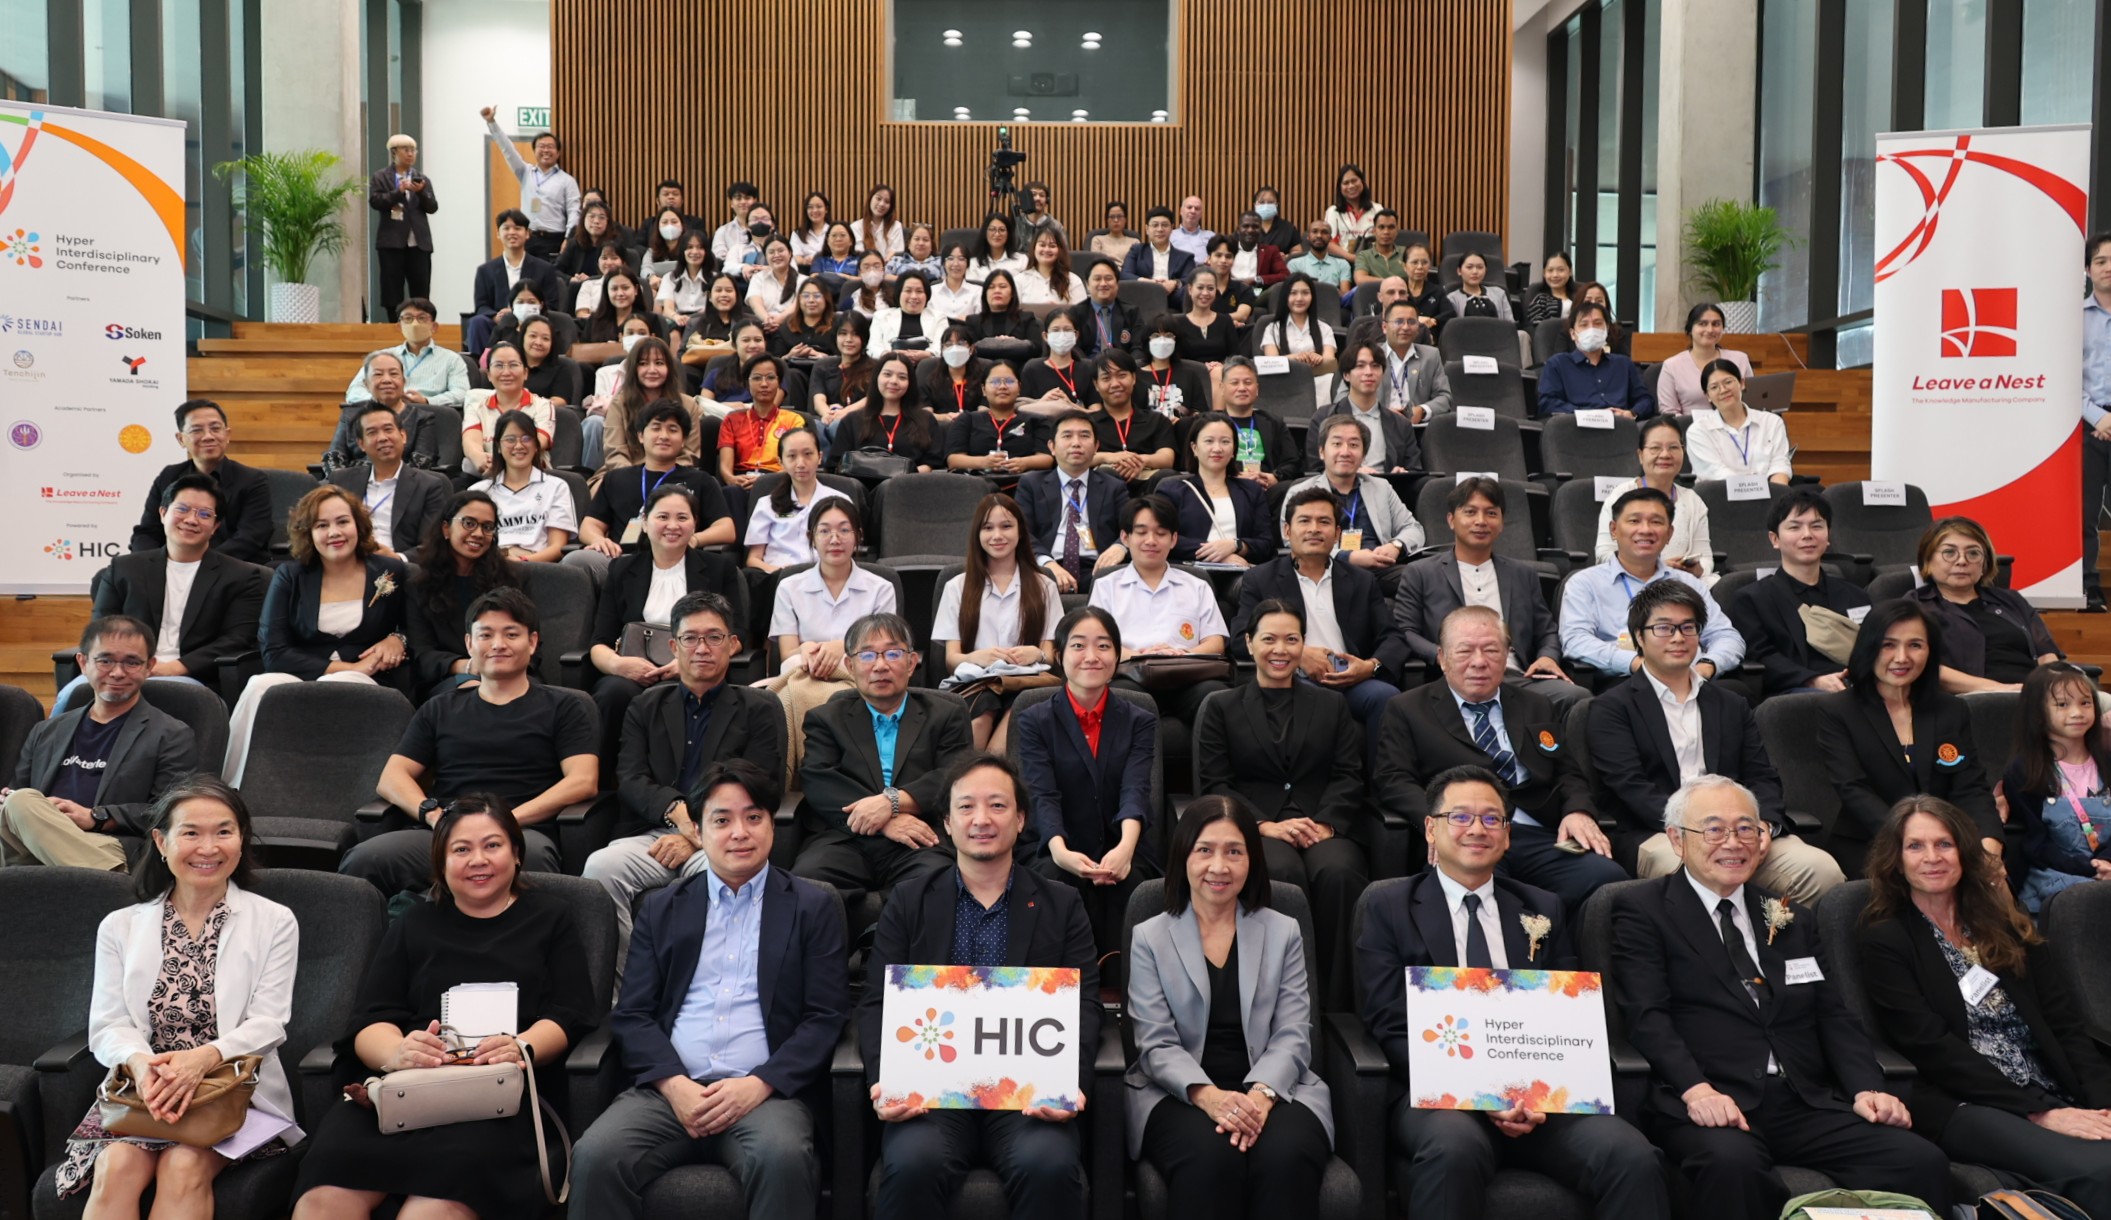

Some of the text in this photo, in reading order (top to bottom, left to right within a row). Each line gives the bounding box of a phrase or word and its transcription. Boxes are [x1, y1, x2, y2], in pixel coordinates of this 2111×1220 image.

[519, 108, 551, 126] EXIT
[56, 234, 95, 247] Hyper
[56, 247, 161, 265] Interdisciplinary
[56, 260, 130, 274] Conference
[17, 318, 62, 332] SENDAI
[125, 326, 162, 341] Soken
[1912, 374, 2046, 390] Leave a Nest
[56, 488, 88, 497] Leave
[97, 489, 121, 498] Nest
[79, 542, 121, 557] HIC
[1786, 971, 1818, 980] Panelist
[1485, 1018, 1524, 1030] Hyper
[974, 1017, 1066, 1057] HIC
[1486, 1033, 1594, 1049] Interdisciplinary
[1487, 1048, 1565, 1061] Conference
